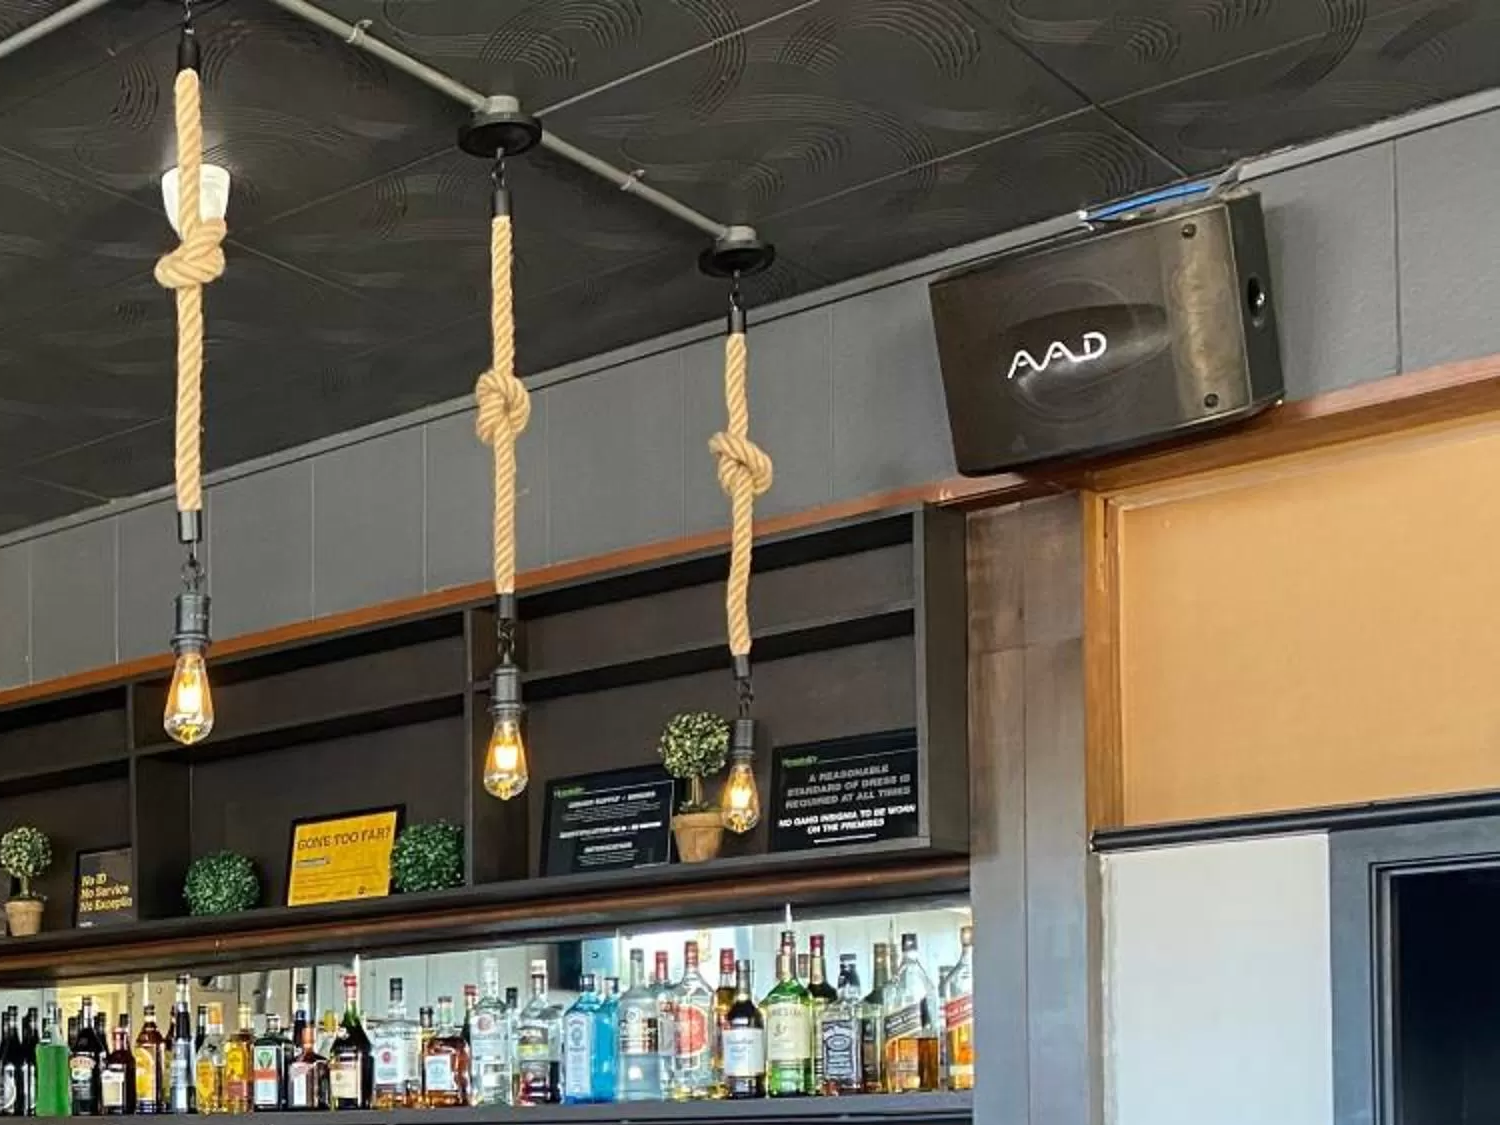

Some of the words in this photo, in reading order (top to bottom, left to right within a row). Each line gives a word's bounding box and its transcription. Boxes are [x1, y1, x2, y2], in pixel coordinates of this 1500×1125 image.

[1007, 331, 1107, 379] AAD
[787, 783, 842, 797] STANDARD
[844, 780, 859, 790] OF
[861, 775, 898, 788] DRESS
[841, 792, 853, 802] AT
[856, 790, 875, 801] ALL
[778, 819, 793, 827] NO
[859, 809, 873, 818] TO
[822, 823, 839, 832] THE
[298, 835, 331, 850] GONE
[334, 831, 359, 845] TOO
[361, 826, 391, 843] FAR?
